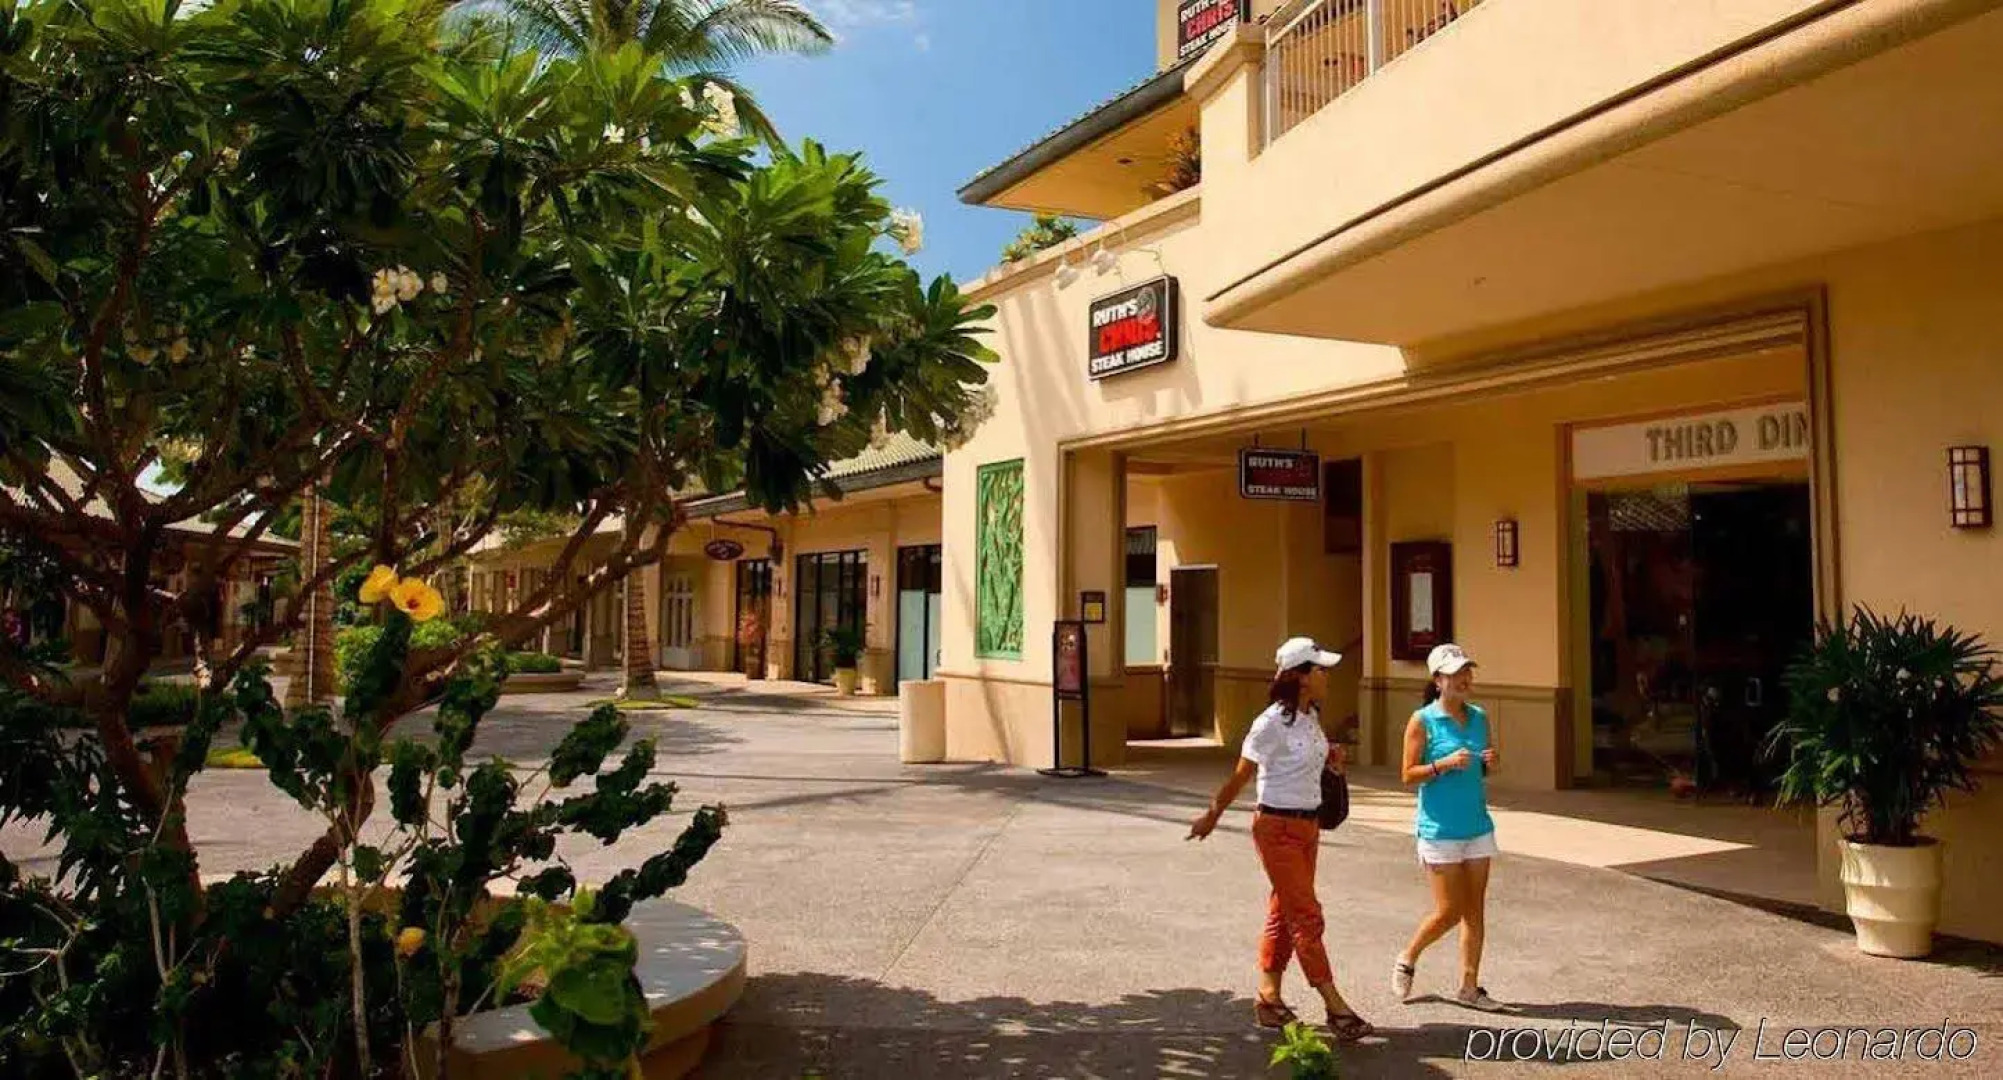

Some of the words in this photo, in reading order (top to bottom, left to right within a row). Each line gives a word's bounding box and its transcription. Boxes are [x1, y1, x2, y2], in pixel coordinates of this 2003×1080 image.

[1180, 36, 1207, 57] STEAK
[1208, 14, 1239, 39] HOUSE
[1186, 3, 1234, 40] CHRIS
[1093, 298, 1138, 327] RUTH'S
[1091, 352, 1125, 373] STEAK
[1126, 341, 1163, 363] HOUSE
[1646, 418, 1739, 461] THIRD
